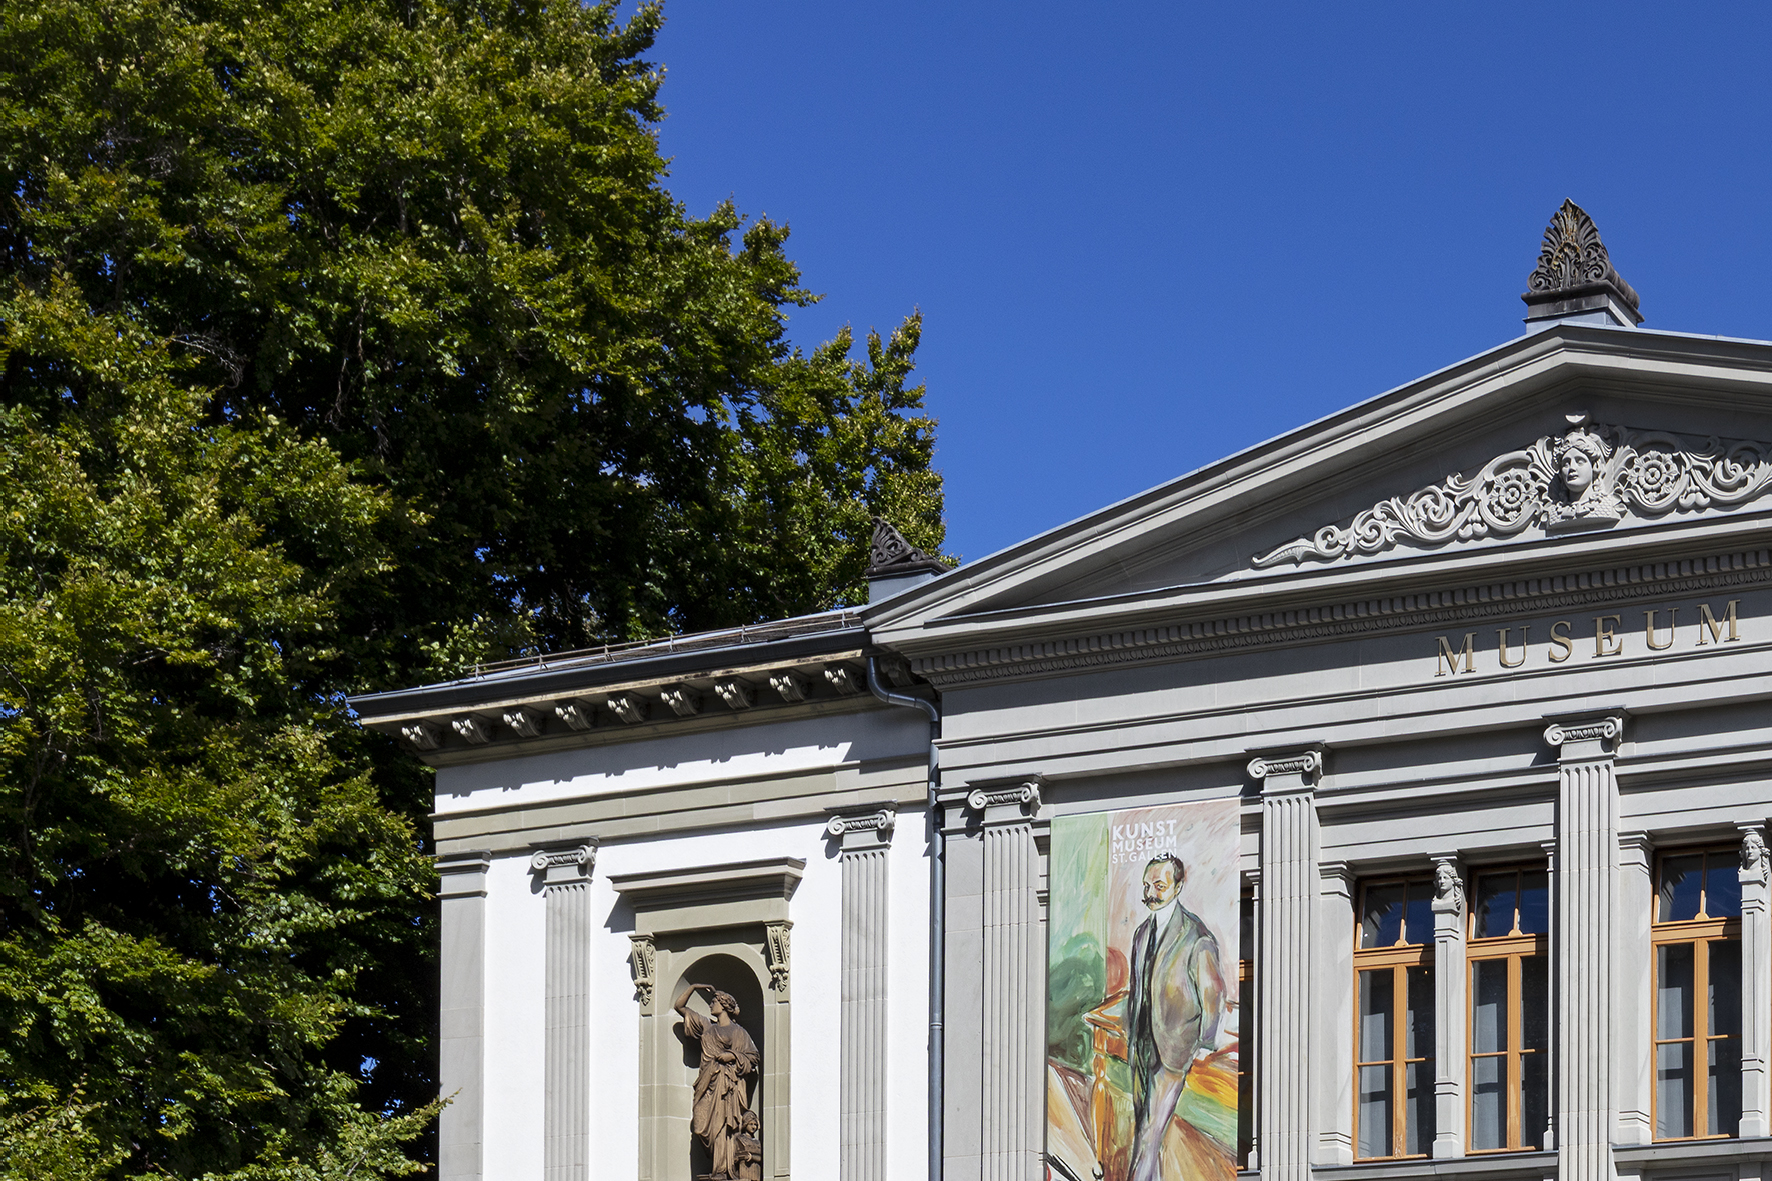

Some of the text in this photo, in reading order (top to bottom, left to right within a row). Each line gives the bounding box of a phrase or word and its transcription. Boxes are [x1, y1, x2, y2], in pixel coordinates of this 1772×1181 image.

[1434, 599, 1741, 677] MUSEUM
[1112, 820, 1177, 840] KUNST
[1112, 835, 1177, 853] MUSEUM
